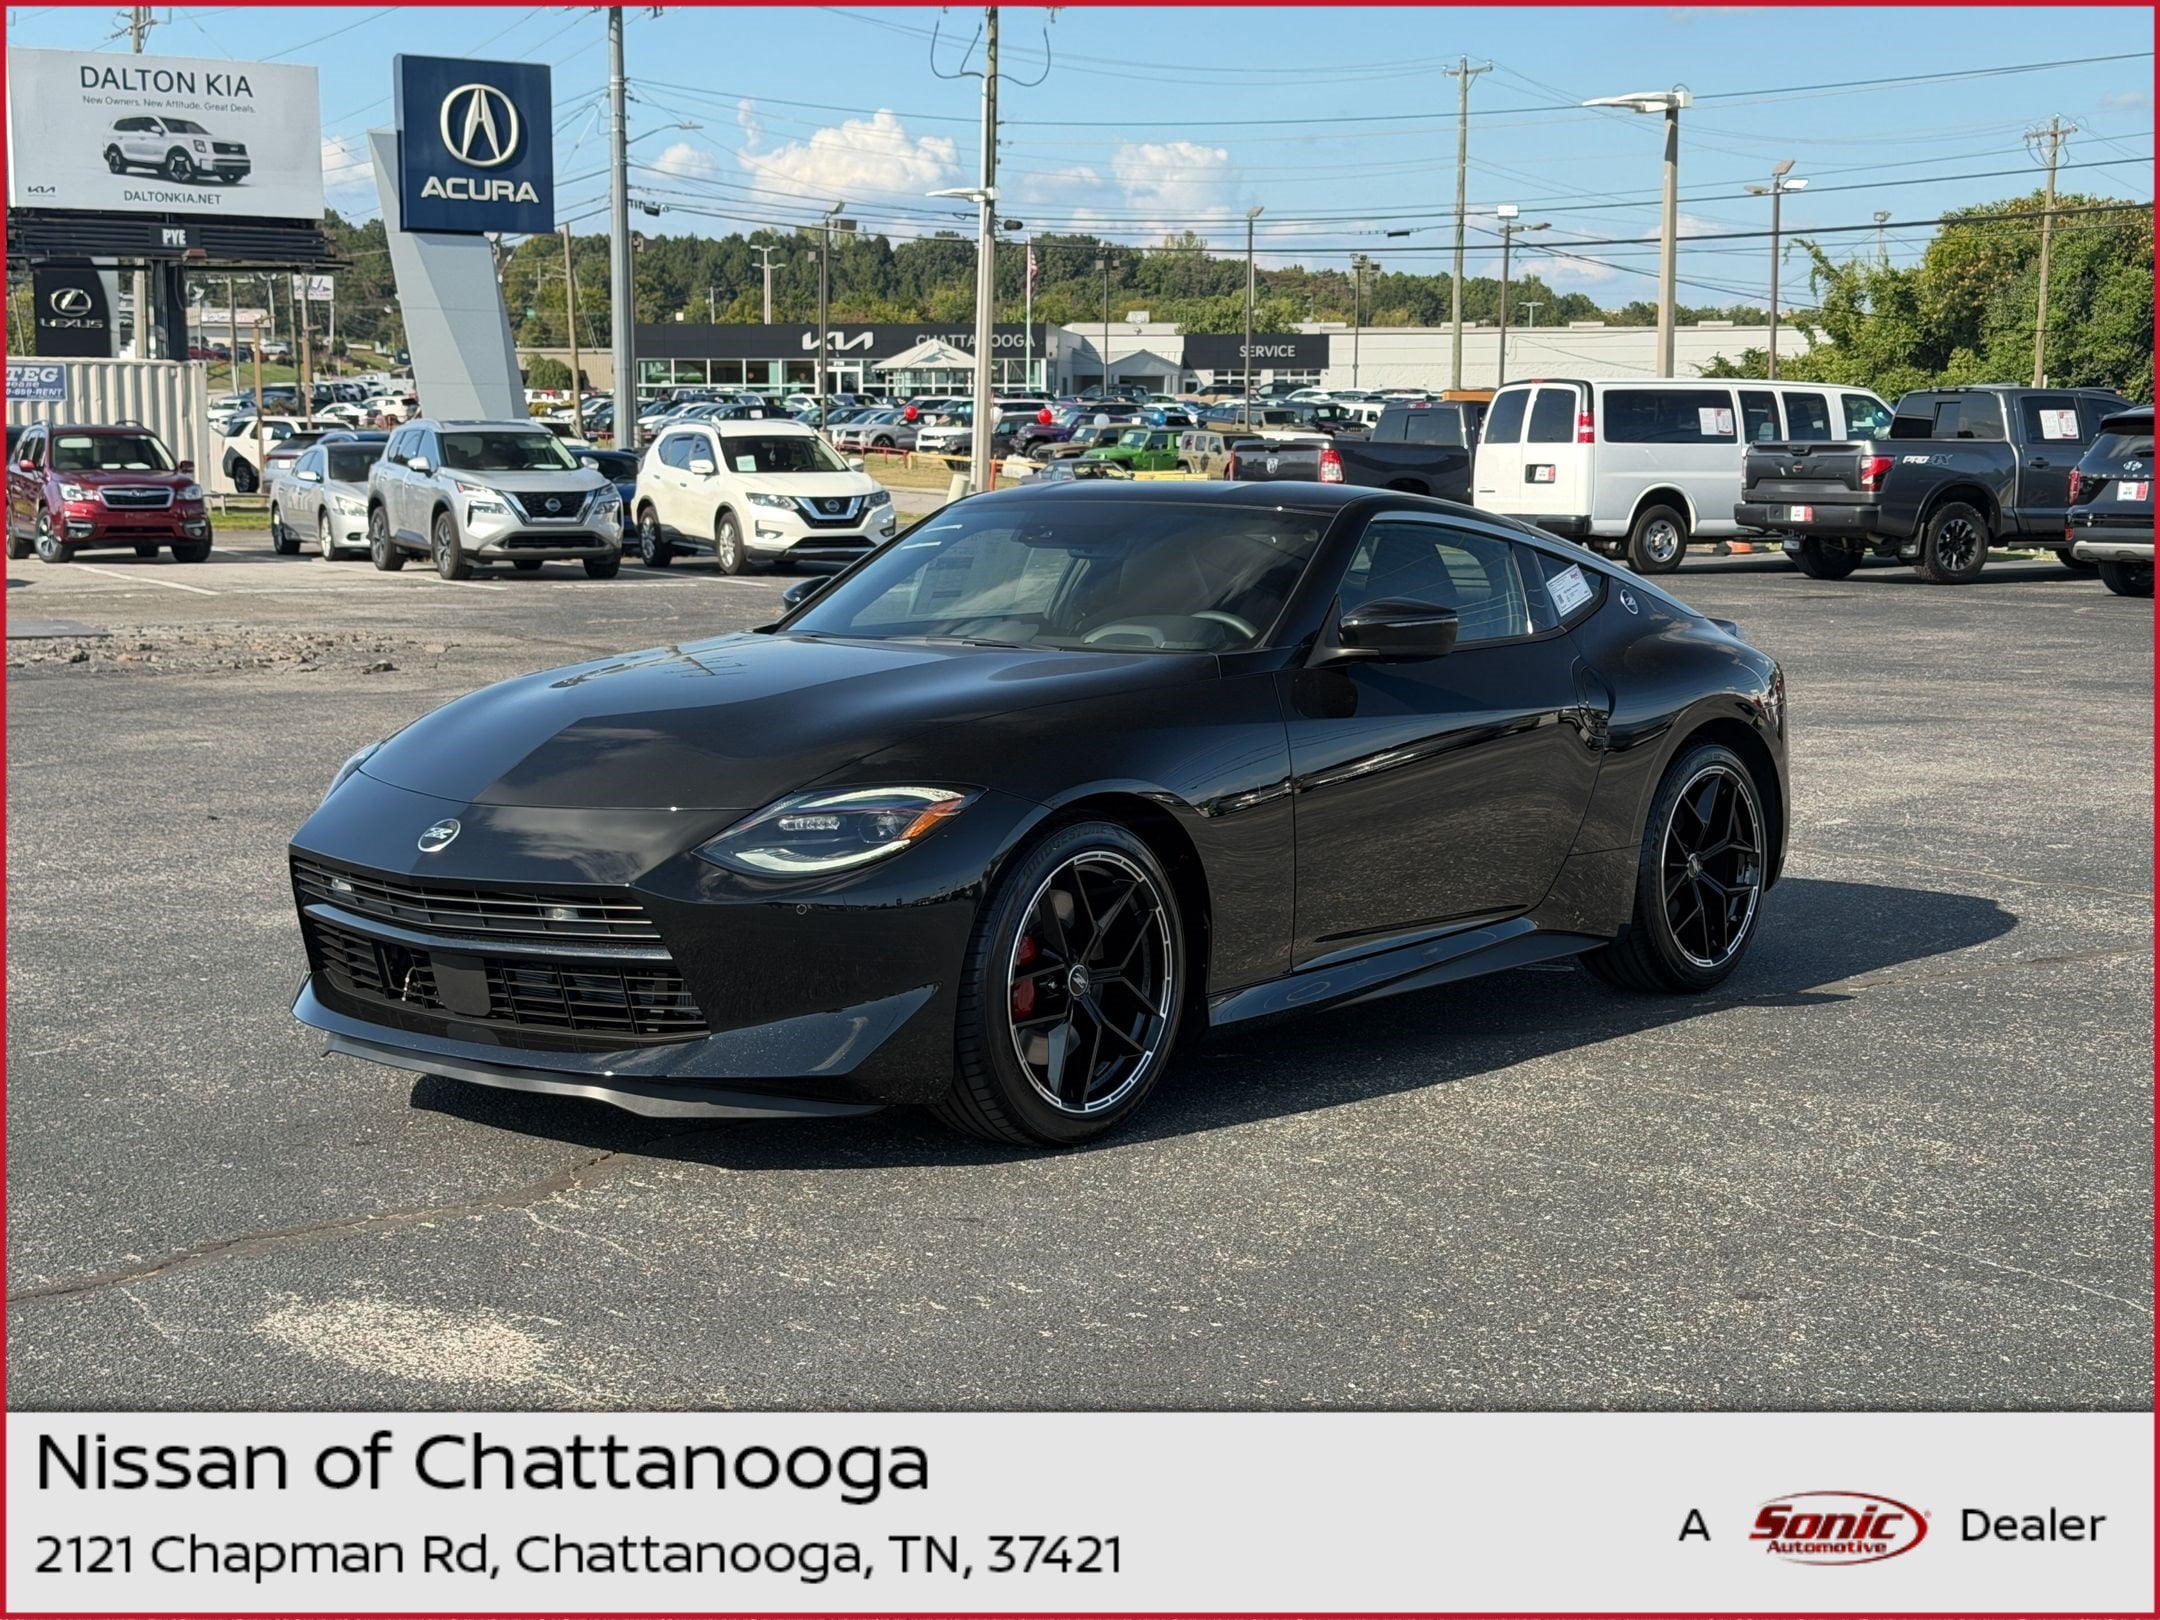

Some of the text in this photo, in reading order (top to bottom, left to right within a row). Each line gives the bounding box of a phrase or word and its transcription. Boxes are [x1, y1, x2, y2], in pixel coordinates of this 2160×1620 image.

[80, 65, 253, 98] DALTON KIA
[82, 95, 256, 114] New Owners. New Attitude. Great Deals.
[123, 189, 222, 206] DALTONKIA.NET
[420, 176, 539, 203] ACURA
[161, 228, 187, 246] PYE
[40, 317, 103, 330] LEXUS
[1239, 344, 1296, 358] SERVICE
